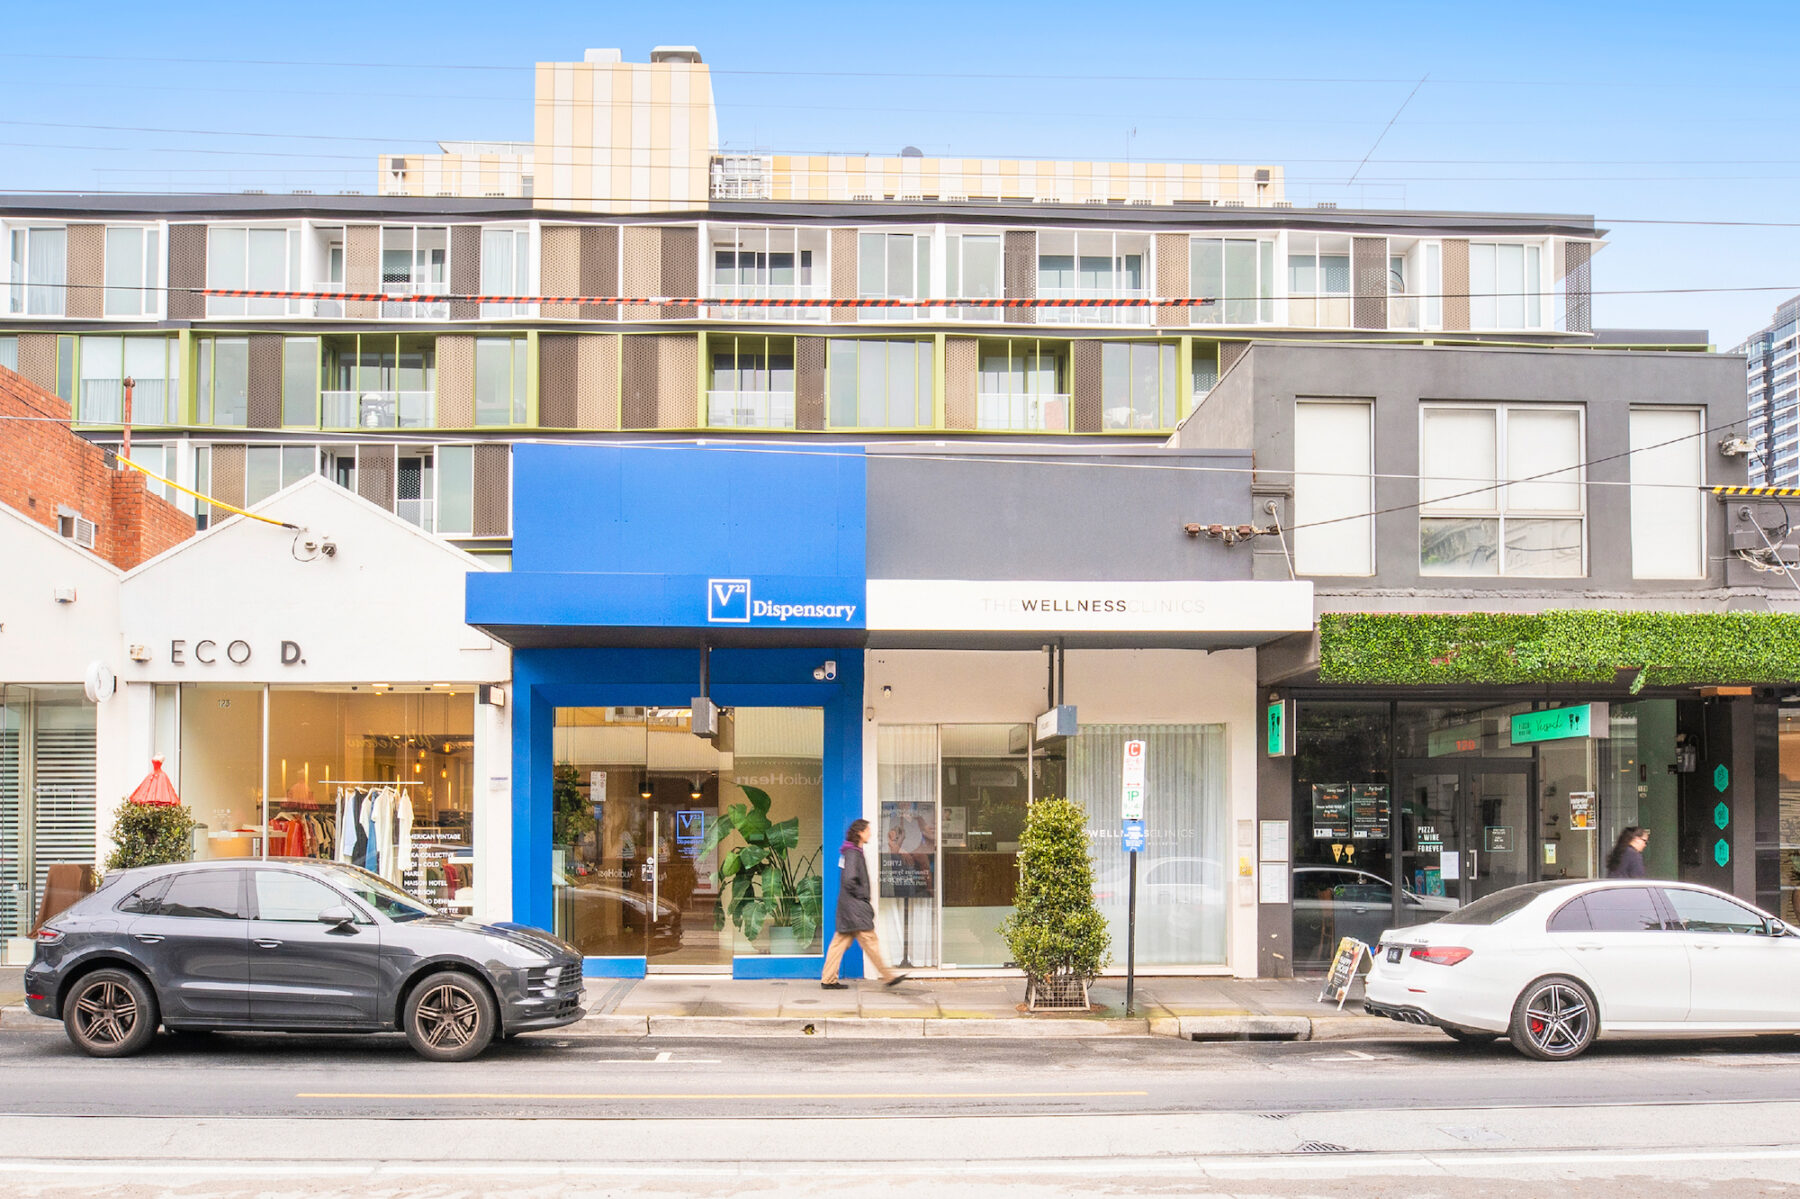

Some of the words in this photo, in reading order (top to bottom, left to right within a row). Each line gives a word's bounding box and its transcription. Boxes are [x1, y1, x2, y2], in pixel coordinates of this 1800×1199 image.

[753, 600, 856, 621] Dispensary
[171, 639, 252, 664] ECO
[281, 640, 307, 665] D.
[1127, 790, 1140, 801] 1P
